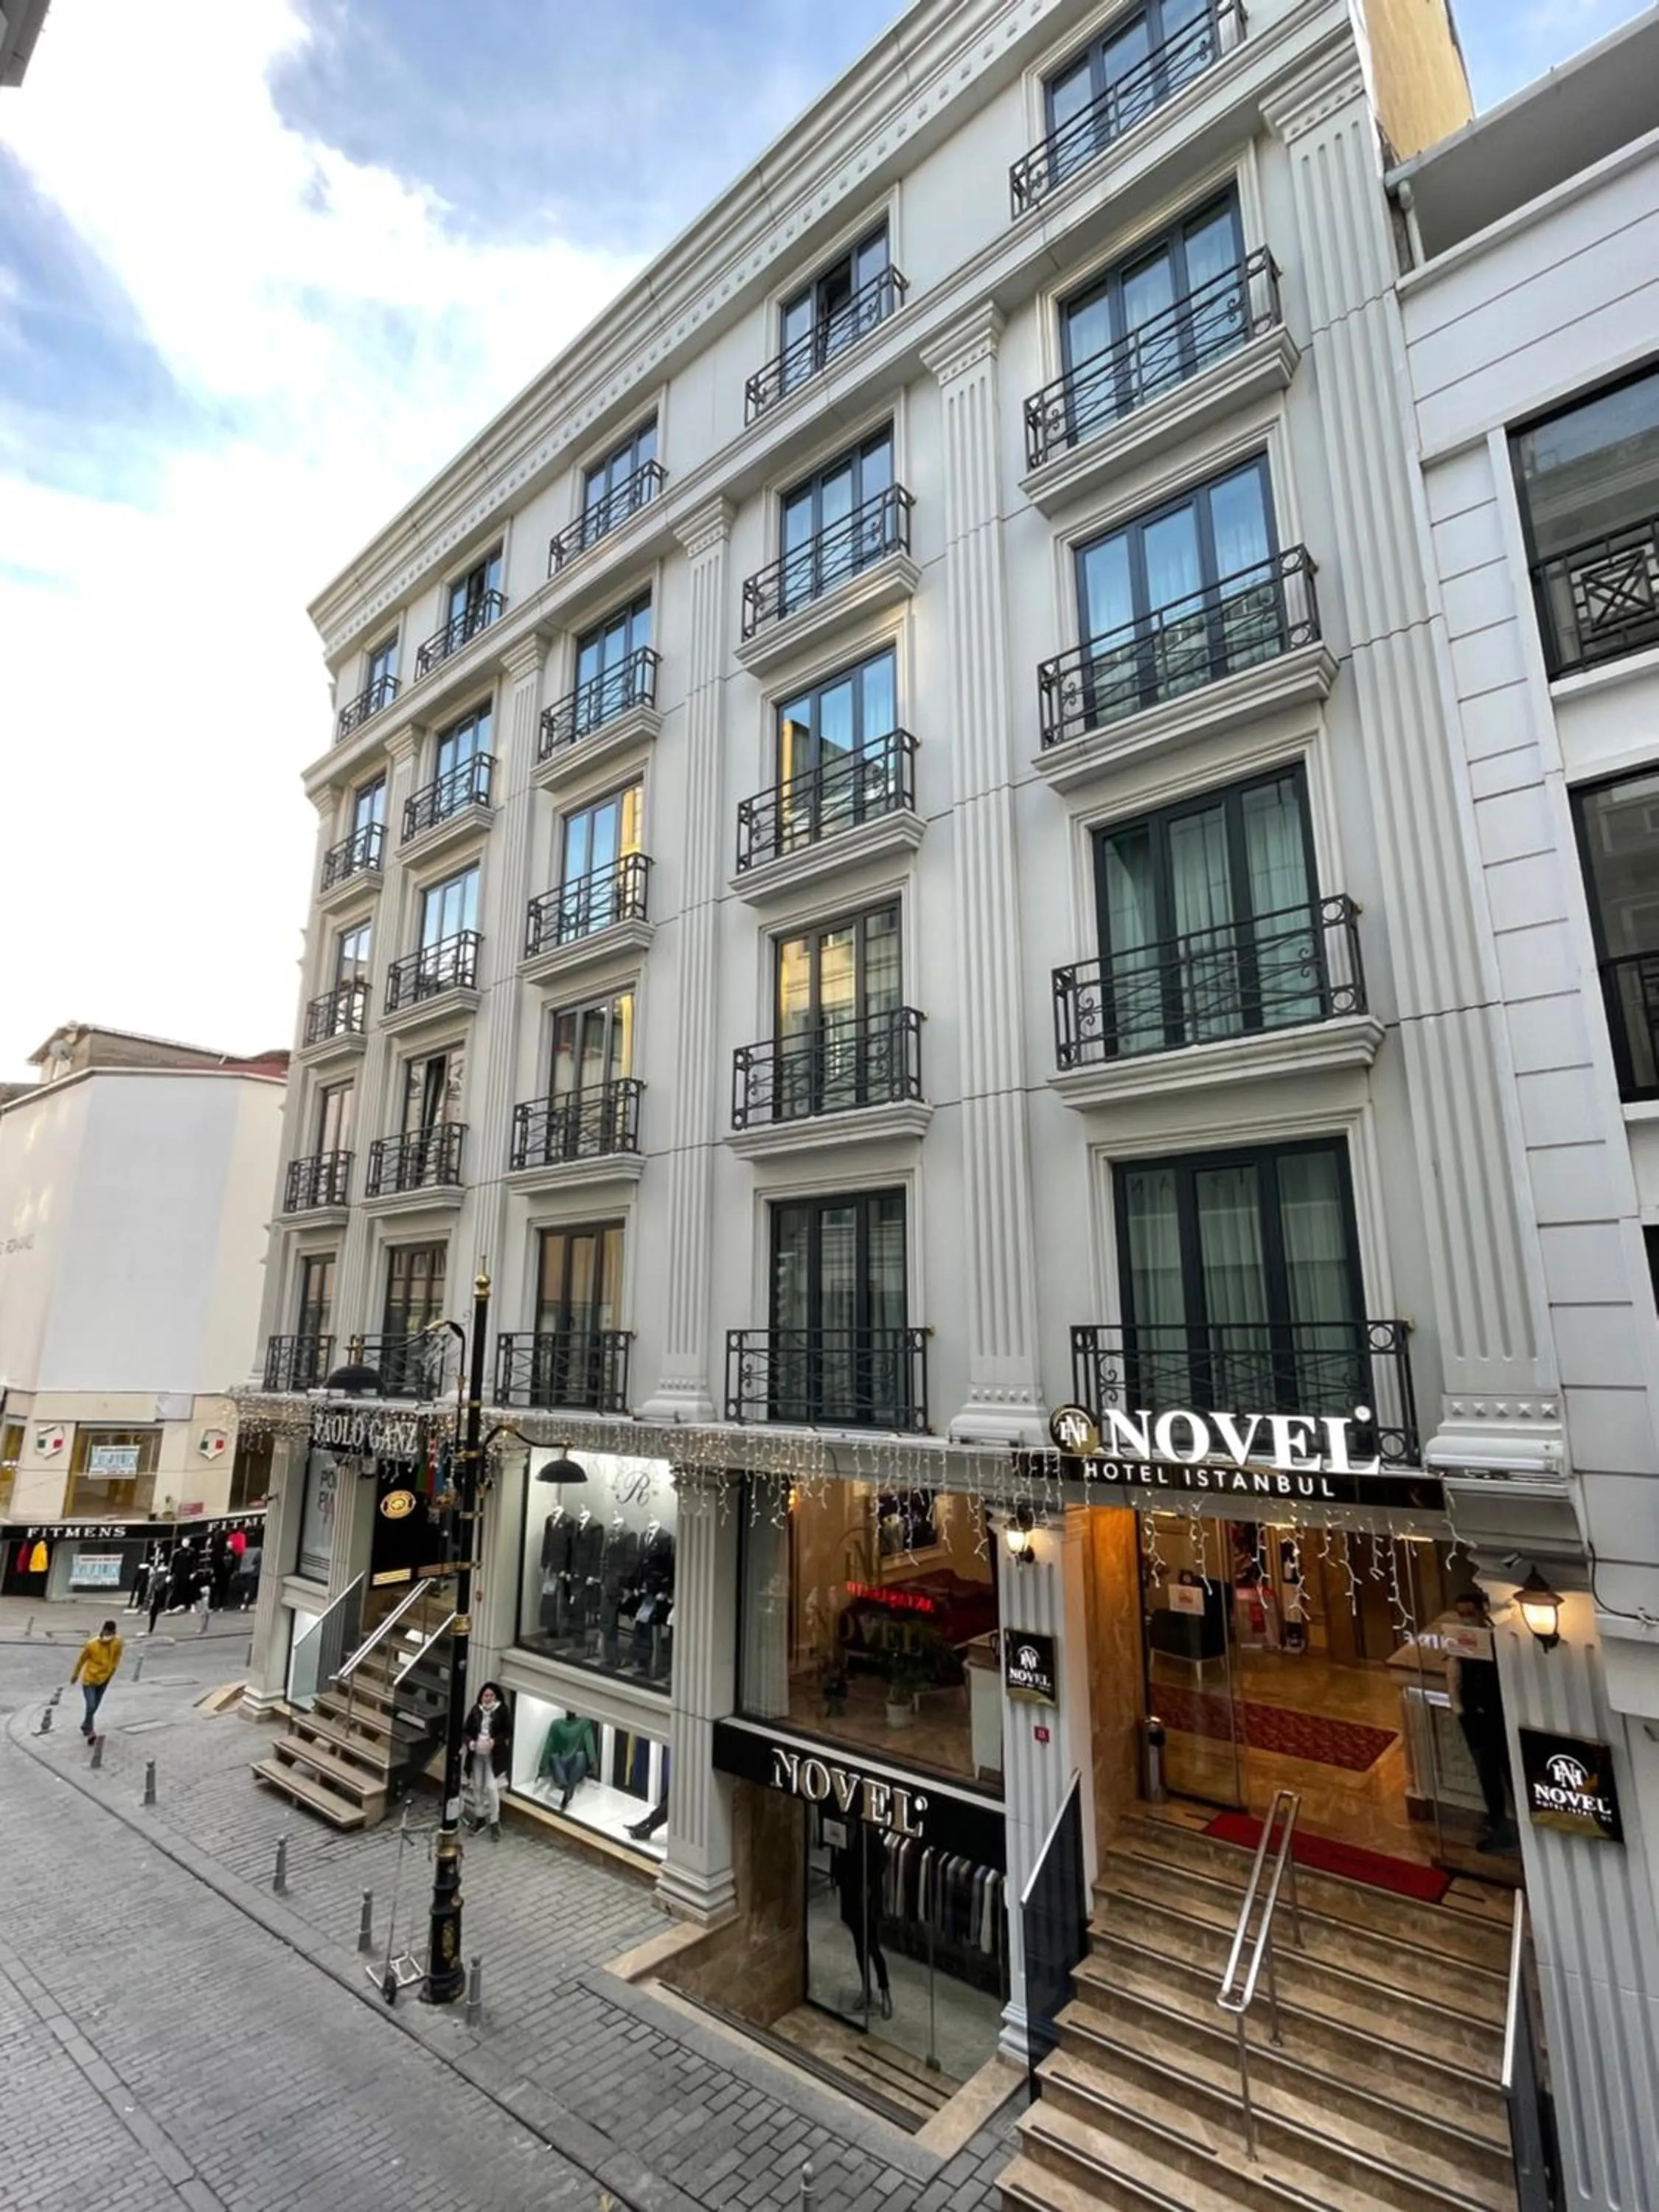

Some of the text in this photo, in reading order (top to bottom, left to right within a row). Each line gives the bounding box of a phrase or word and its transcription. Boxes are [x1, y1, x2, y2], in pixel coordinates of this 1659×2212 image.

[313, 1413, 419, 1454] PAOLO GANZ
[1105, 1407, 1380, 1475] NOVEL
[1085, 1462, 1335, 1497] HOTEL ISTANBUL
[27, 1526, 127, 1538] FITMENS
[1009, 1667, 1051, 1686] NOVEL
[769, 1747, 924, 1838] NOVEL
[1534, 1783, 1613, 1815] NOVEL
